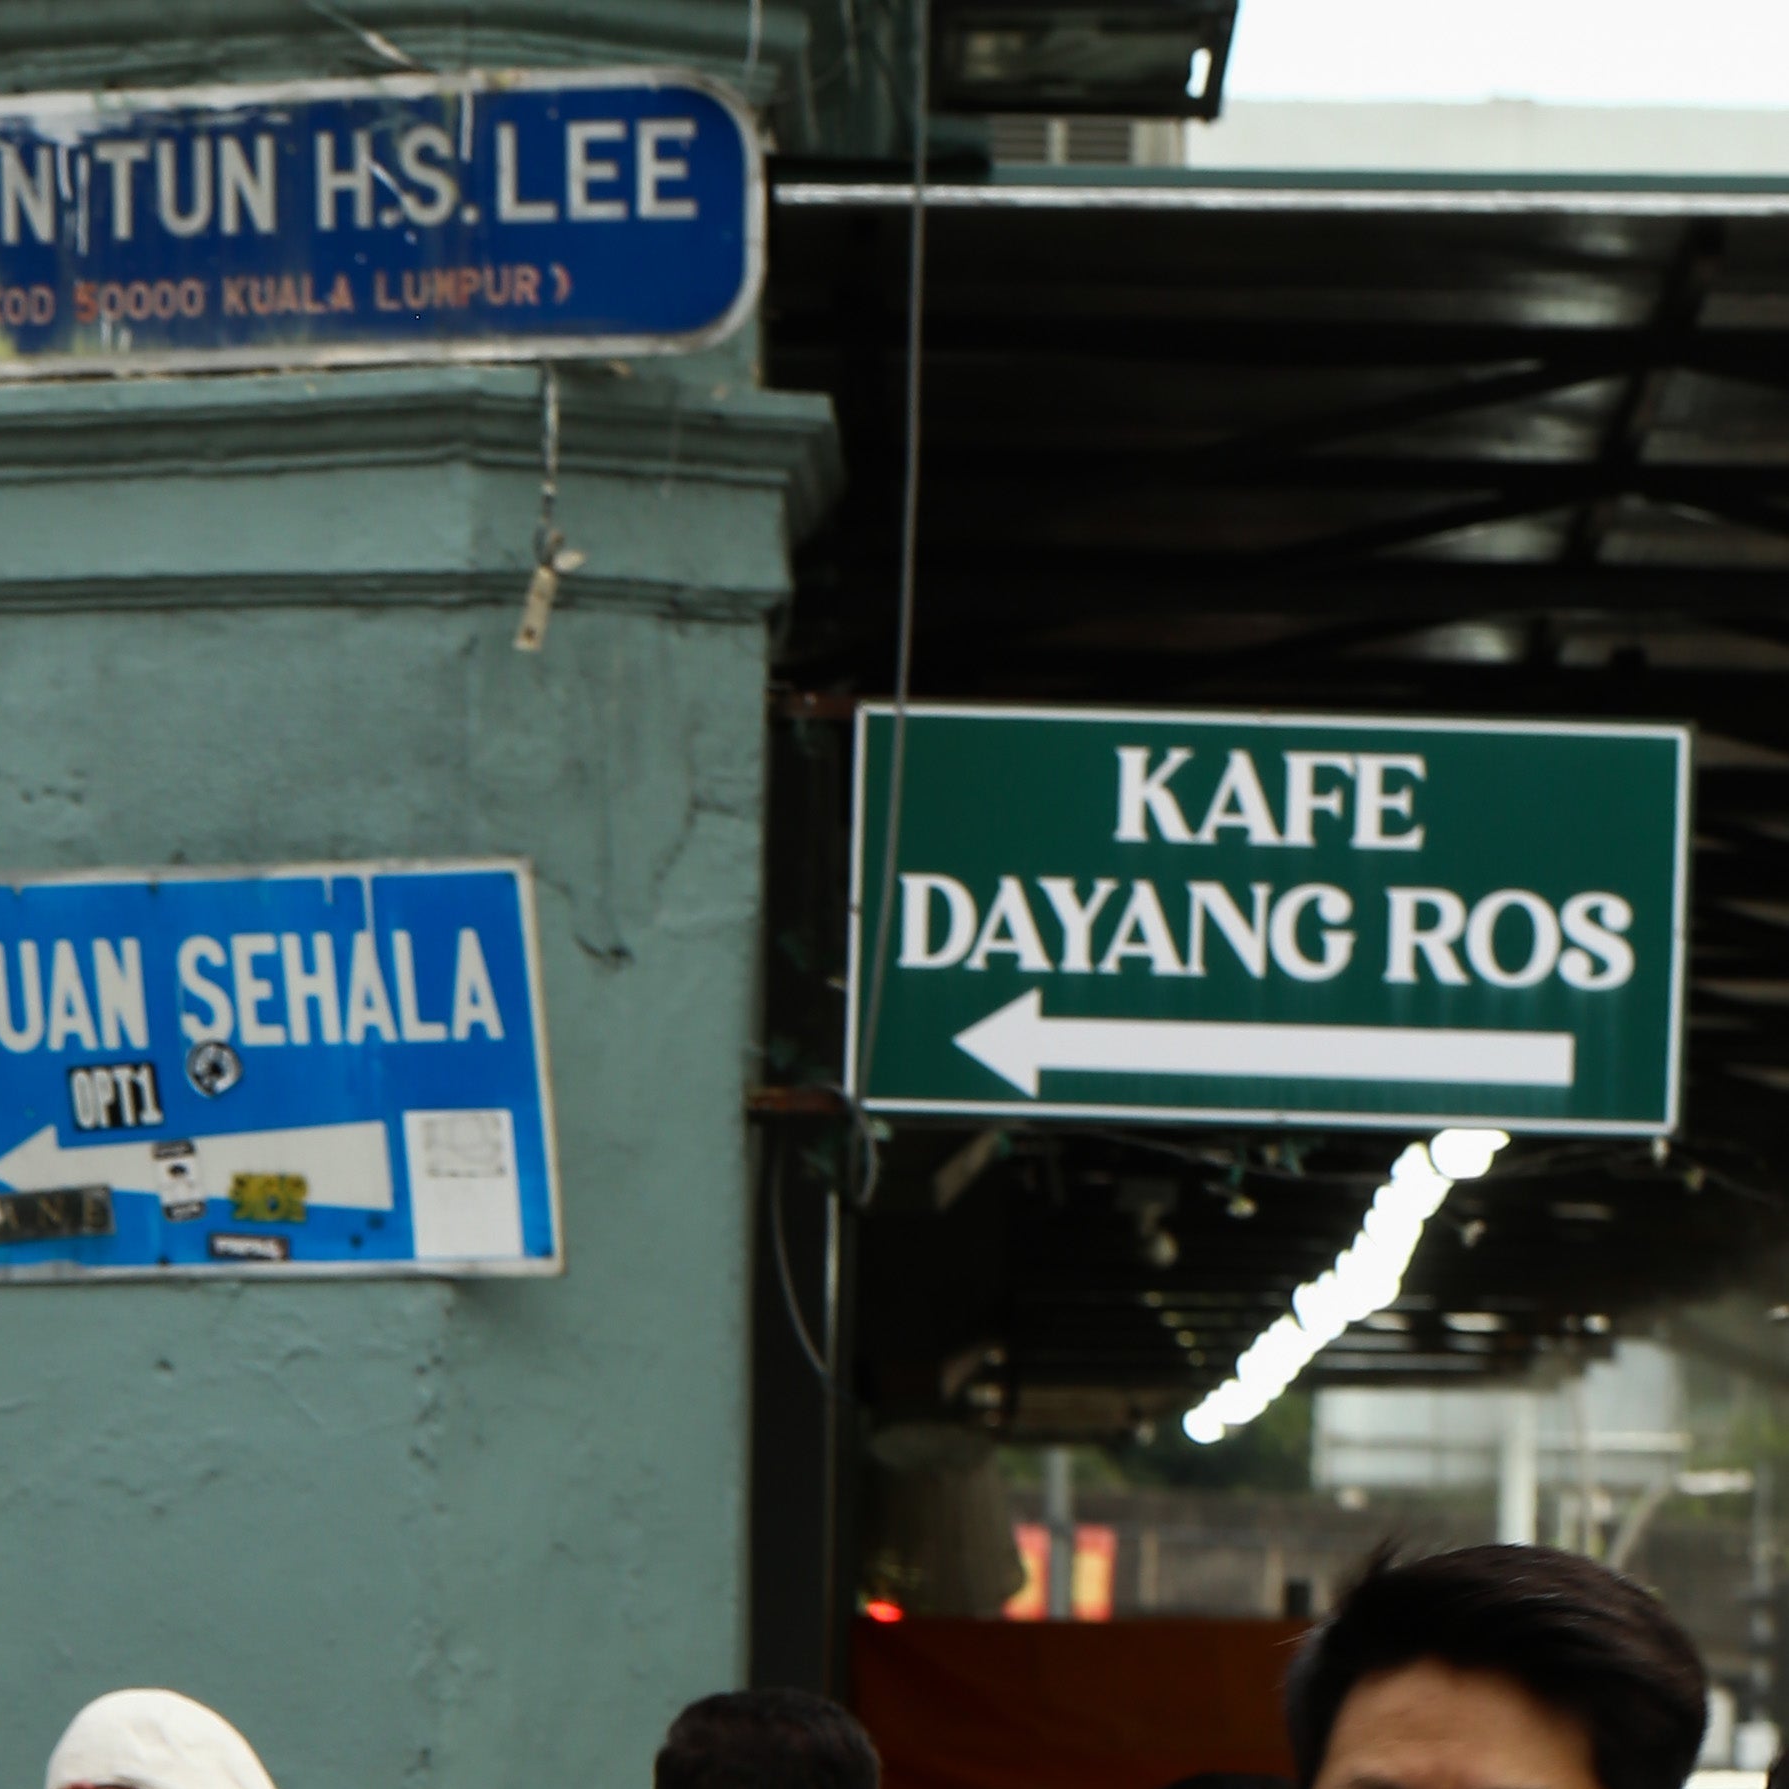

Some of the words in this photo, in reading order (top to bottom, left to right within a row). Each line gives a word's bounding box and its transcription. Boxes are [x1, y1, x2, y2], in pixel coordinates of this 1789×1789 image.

[94, 136, 276, 240] TUN
[72, 278, 206, 325] 50000
[222, 270, 356, 316] KUALA
[1112, 744, 1428, 852] KAFE
[898, 872, 1357, 984] DAYANG
[1382, 886, 1636, 992] ROS
[177, 926, 506, 1048] SEHALA
